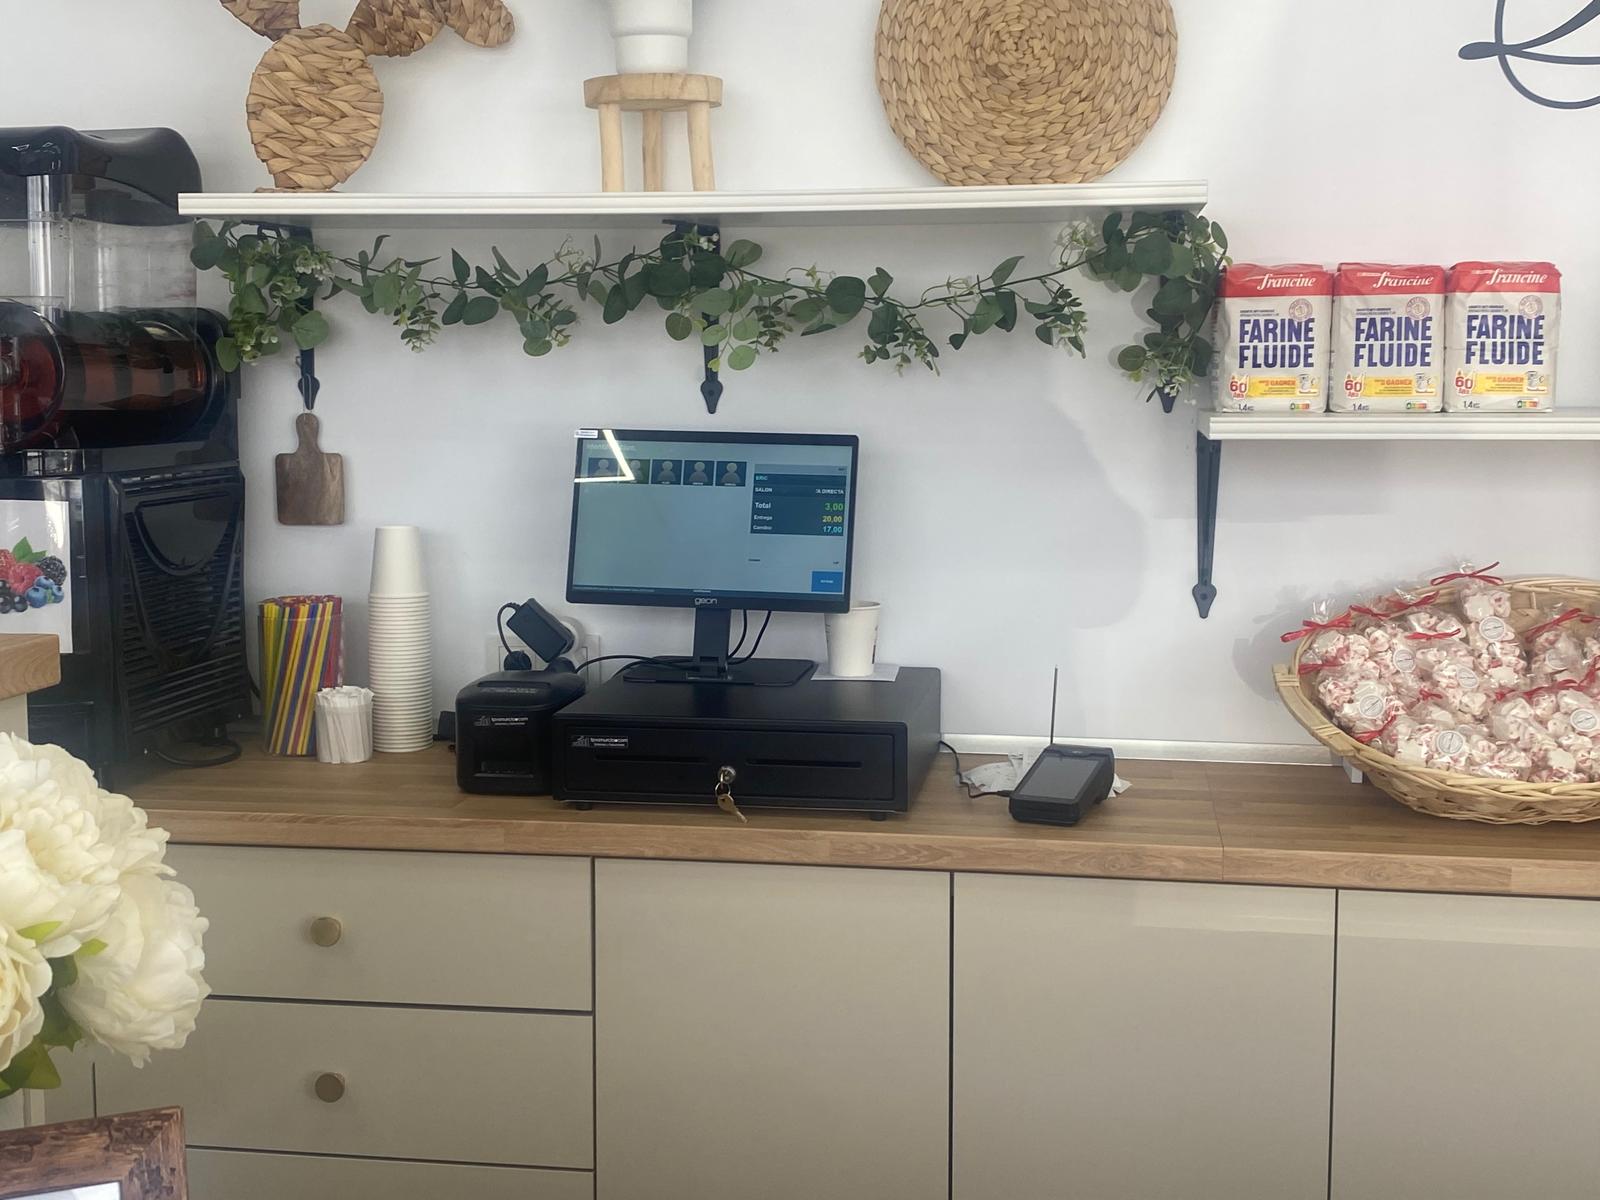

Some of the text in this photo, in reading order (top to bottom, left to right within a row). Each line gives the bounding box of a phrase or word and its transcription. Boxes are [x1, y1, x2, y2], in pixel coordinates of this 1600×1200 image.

[1256, 273, 1317, 291] francine
[1372, 271, 1434, 288] francine
[1486, 268, 1548, 285] francine
[1239, 317, 1315, 344] FARINE
[1354, 316, 1433, 342] FARINE
[1466, 314, 1545, 340] FARINE
[1238, 343, 1315, 369] FLUIDE
[1354, 342, 1432, 368] FLUIDE
[1465, 340, 1545, 366] FLUIDE
[1229, 380, 1248, 394] 60
[1344, 379, 1363, 393] 60
[1455, 376, 1474, 390] 60
[824, 502, 844, 512] 3,00
[822, 515, 843, 523] 20,00
[823, 525, 843, 534] 17,00
